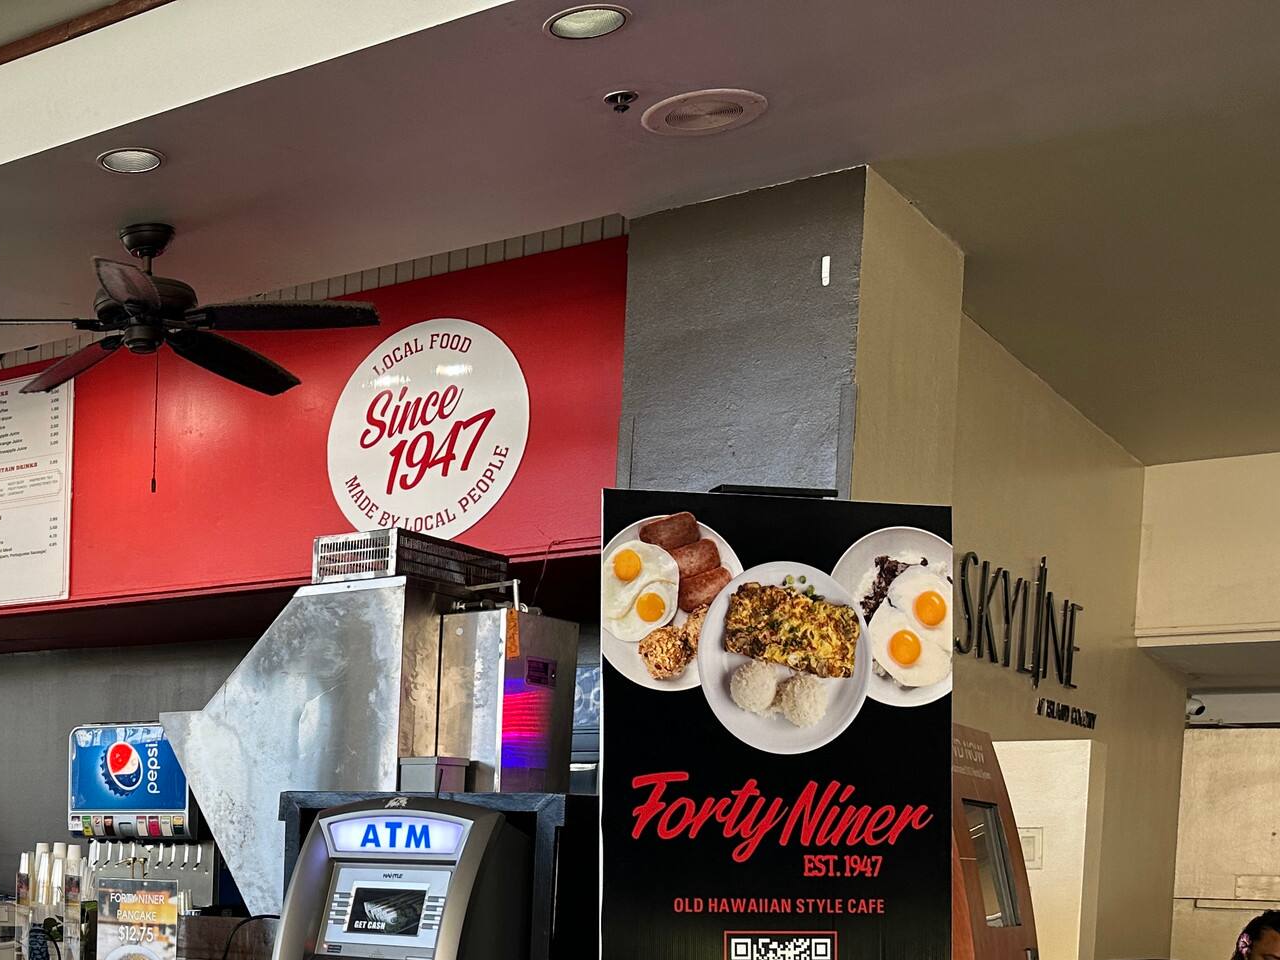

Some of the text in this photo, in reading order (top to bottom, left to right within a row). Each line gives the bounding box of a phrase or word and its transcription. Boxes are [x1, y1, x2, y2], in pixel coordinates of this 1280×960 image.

[372, 333, 472, 376] LOCAL FOOD
[360, 385, 464, 449] Since
[16, 462, 38, 470] DRINKS
[386, 408, 496, 495] 1947
[345, 445, 510, 532] MADE BY LOCAL PEOPLE
[954, 551, 1084, 691] SKYLINE
[145, 743, 160, 794] pepsi
[631, 771, 934, 863] Forty Niner
[360, 822, 431, 848] ATM
[803, 854, 883, 877] EST. 1947
[116, 910, 157, 921] PANCAKE
[673, 897, 886, 914] OLD HAWAIIAN STYLE CAFE
[119, 925, 154, 943] $12.75
[353, 920, 386, 930] GET CASH
